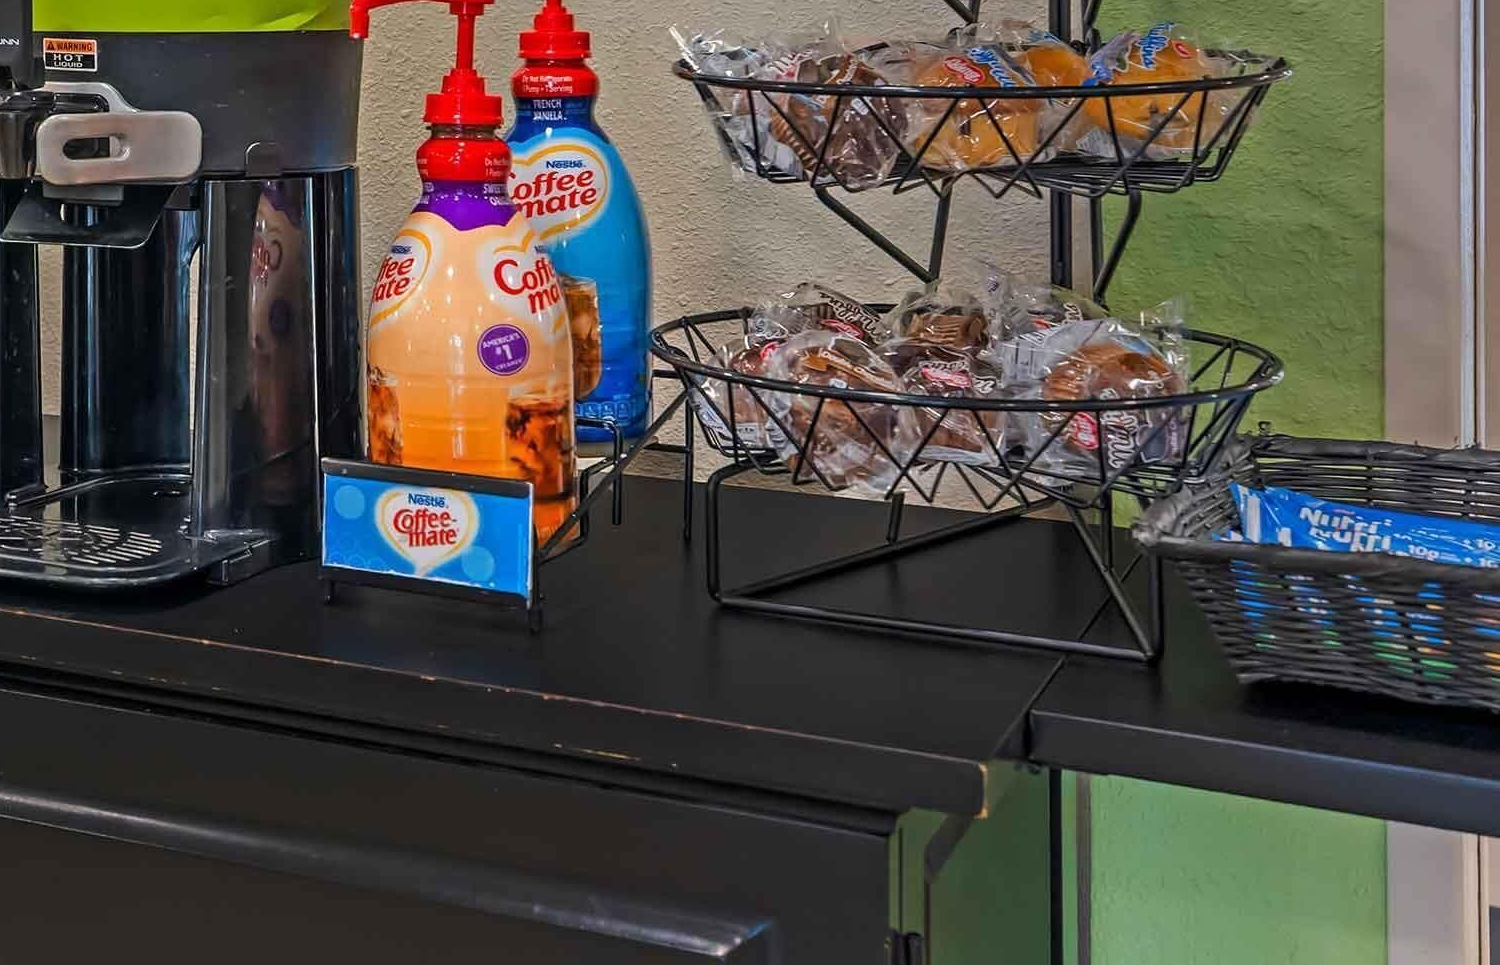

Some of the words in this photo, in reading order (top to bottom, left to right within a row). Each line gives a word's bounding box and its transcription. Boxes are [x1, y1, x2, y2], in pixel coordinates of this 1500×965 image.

[53, 53, 84, 62] HOT
[57, 42, 93, 52] WARNING
[510, 170, 594, 200] offee
[516, 187, 597, 218] mate
[372, 277, 410, 303] ate
[408, 527, 458, 548] mate
